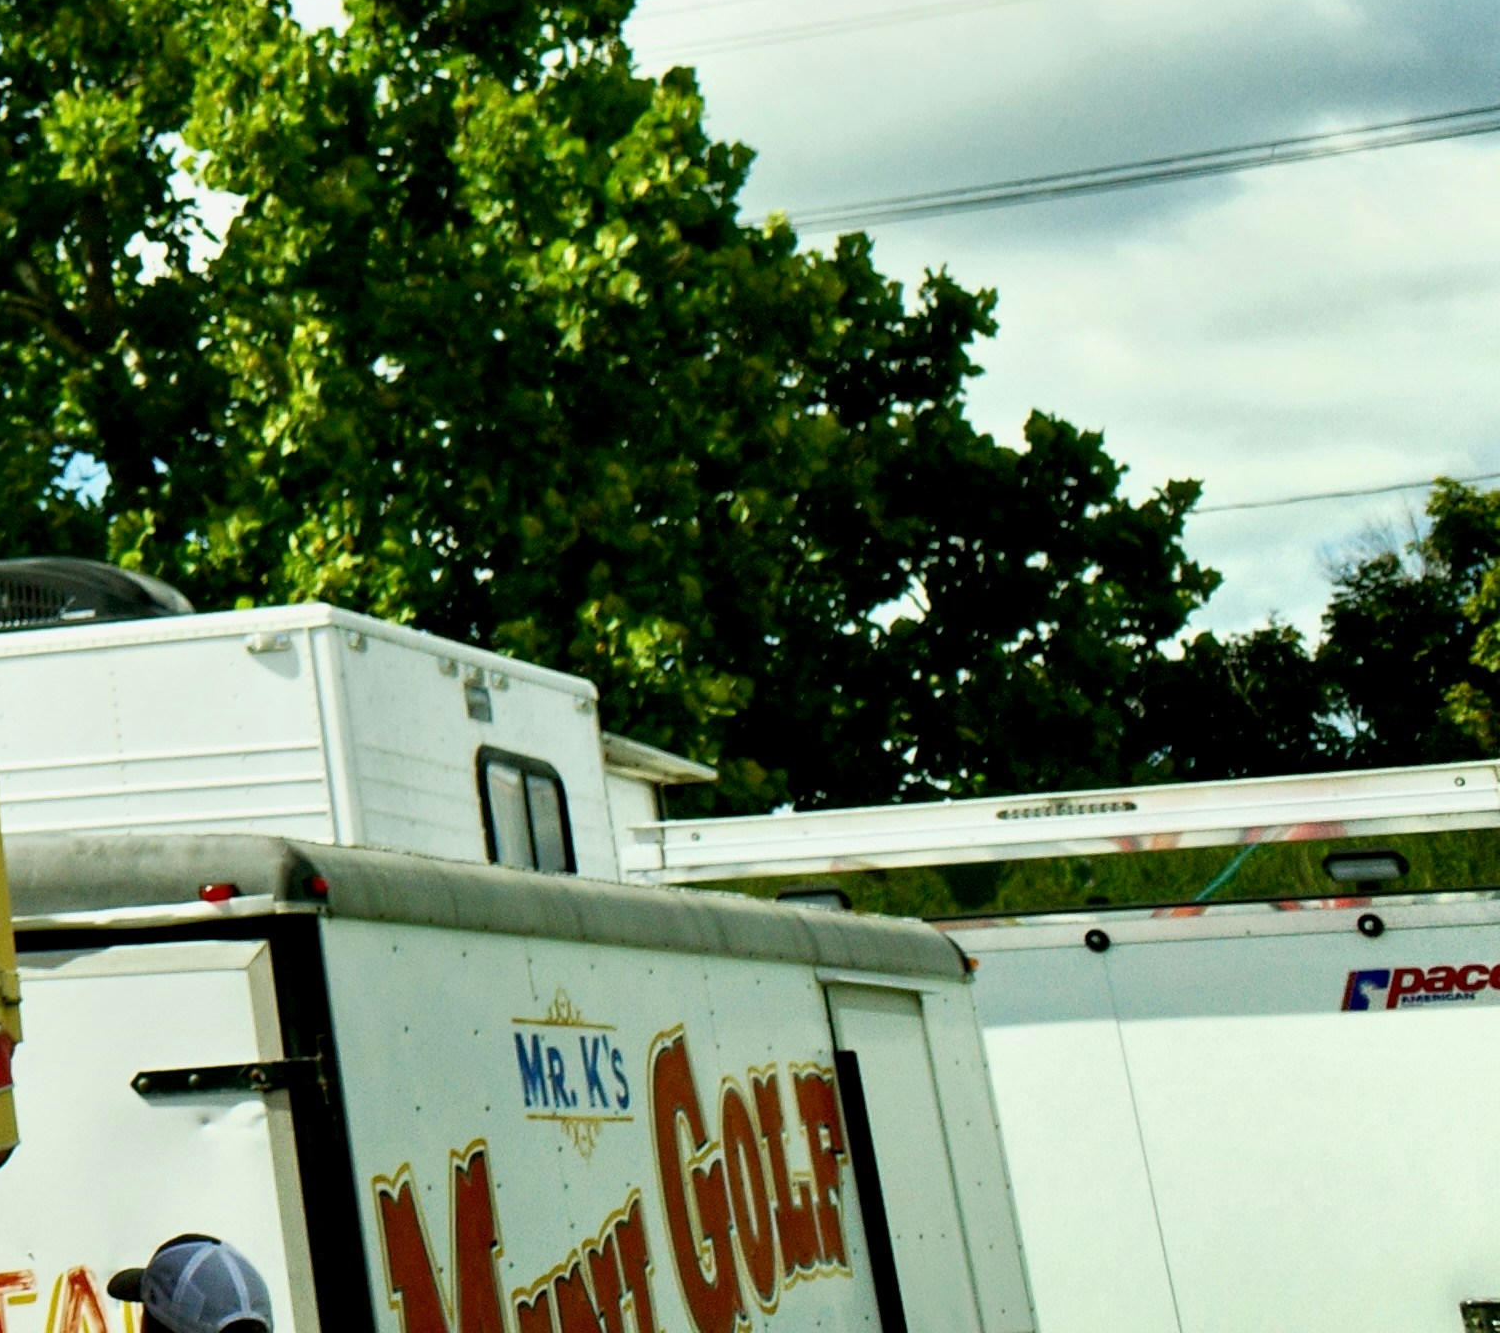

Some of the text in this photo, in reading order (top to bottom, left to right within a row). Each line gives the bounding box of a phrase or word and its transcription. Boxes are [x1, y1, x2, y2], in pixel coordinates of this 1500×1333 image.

[1386, 964, 1500, 1010] pac
[1401, 993, 1476, 1004] AMERICAN
[646, 1023, 854, 1333] GOLF
